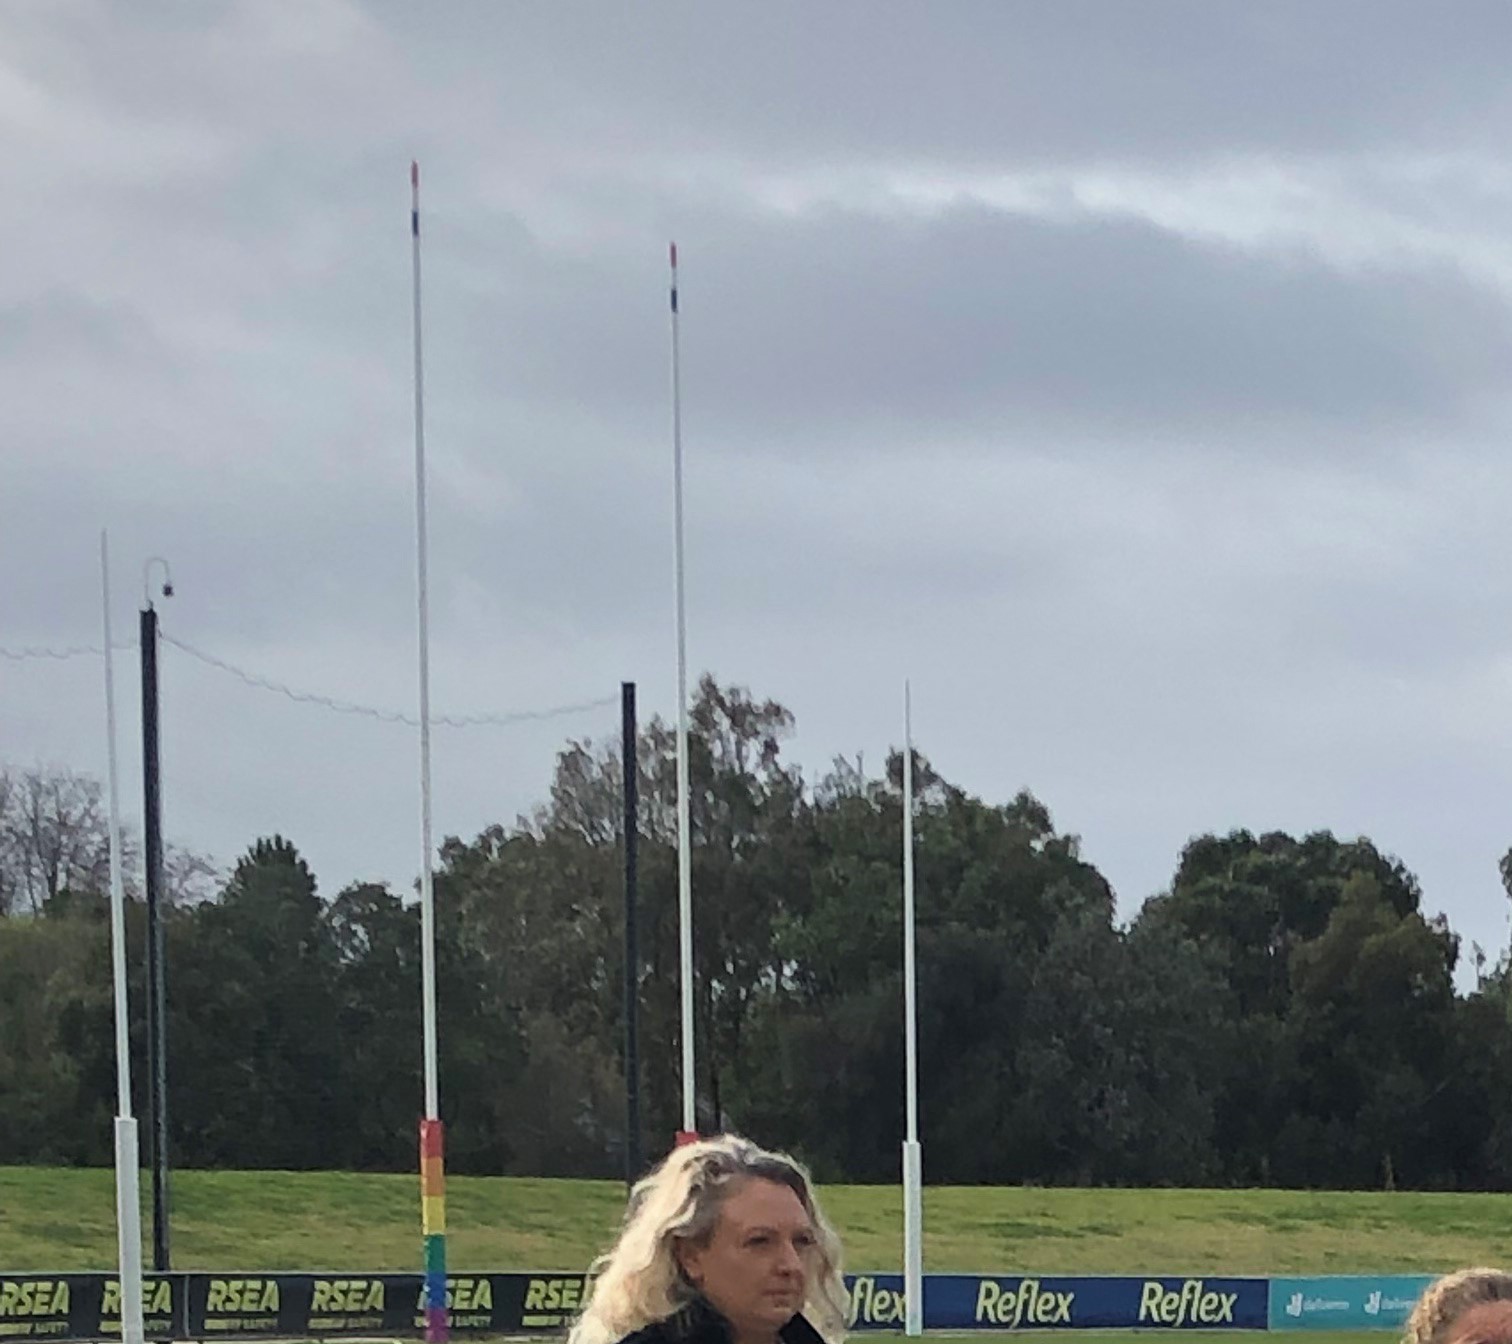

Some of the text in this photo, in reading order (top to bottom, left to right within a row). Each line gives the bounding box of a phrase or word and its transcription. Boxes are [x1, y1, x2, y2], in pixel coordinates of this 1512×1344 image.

[0, 1280, 69, 1315] RSEA
[102, 1280, 172, 1314] REA
[207, 1280, 279, 1312] RSEA
[311, 1280, 385, 1312] RSEA
[525, 1279, 584, 1310] RSE
[848, 1277, 906, 1328] flex
[976, 1279, 1074, 1329] Reflex
[1139, 1280, 1237, 1327] Reflex
